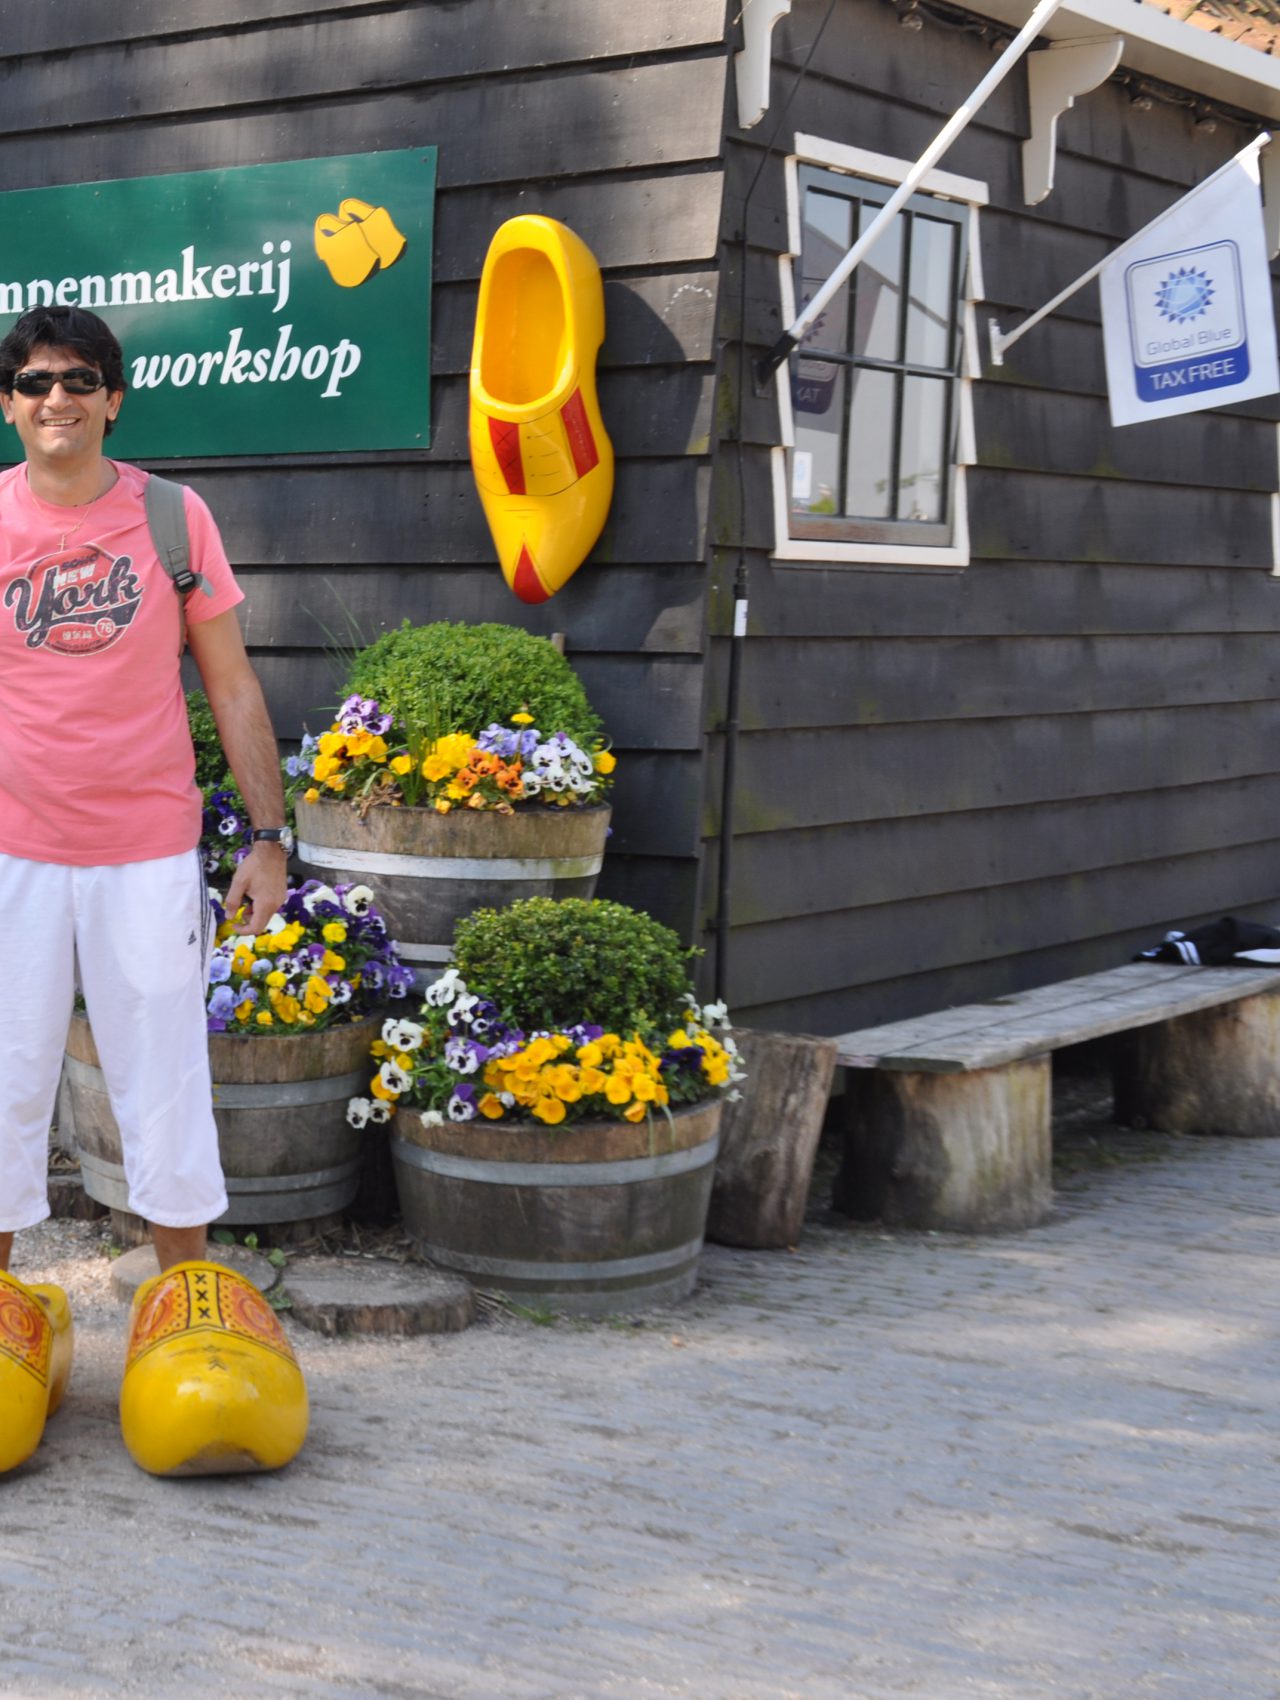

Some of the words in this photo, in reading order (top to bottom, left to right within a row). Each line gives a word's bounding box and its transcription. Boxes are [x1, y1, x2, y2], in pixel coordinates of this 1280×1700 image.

[1146, 333, 1195, 356] Global
[1197, 328, 1232, 345] Blue
[131, 324, 362, 398] workshop
[1149, 368, 1187, 390] TAX
[1187, 357, 1236, 383] FREE
[53, 563, 96, 592] NEW
[3, 554, 145, 650] York
